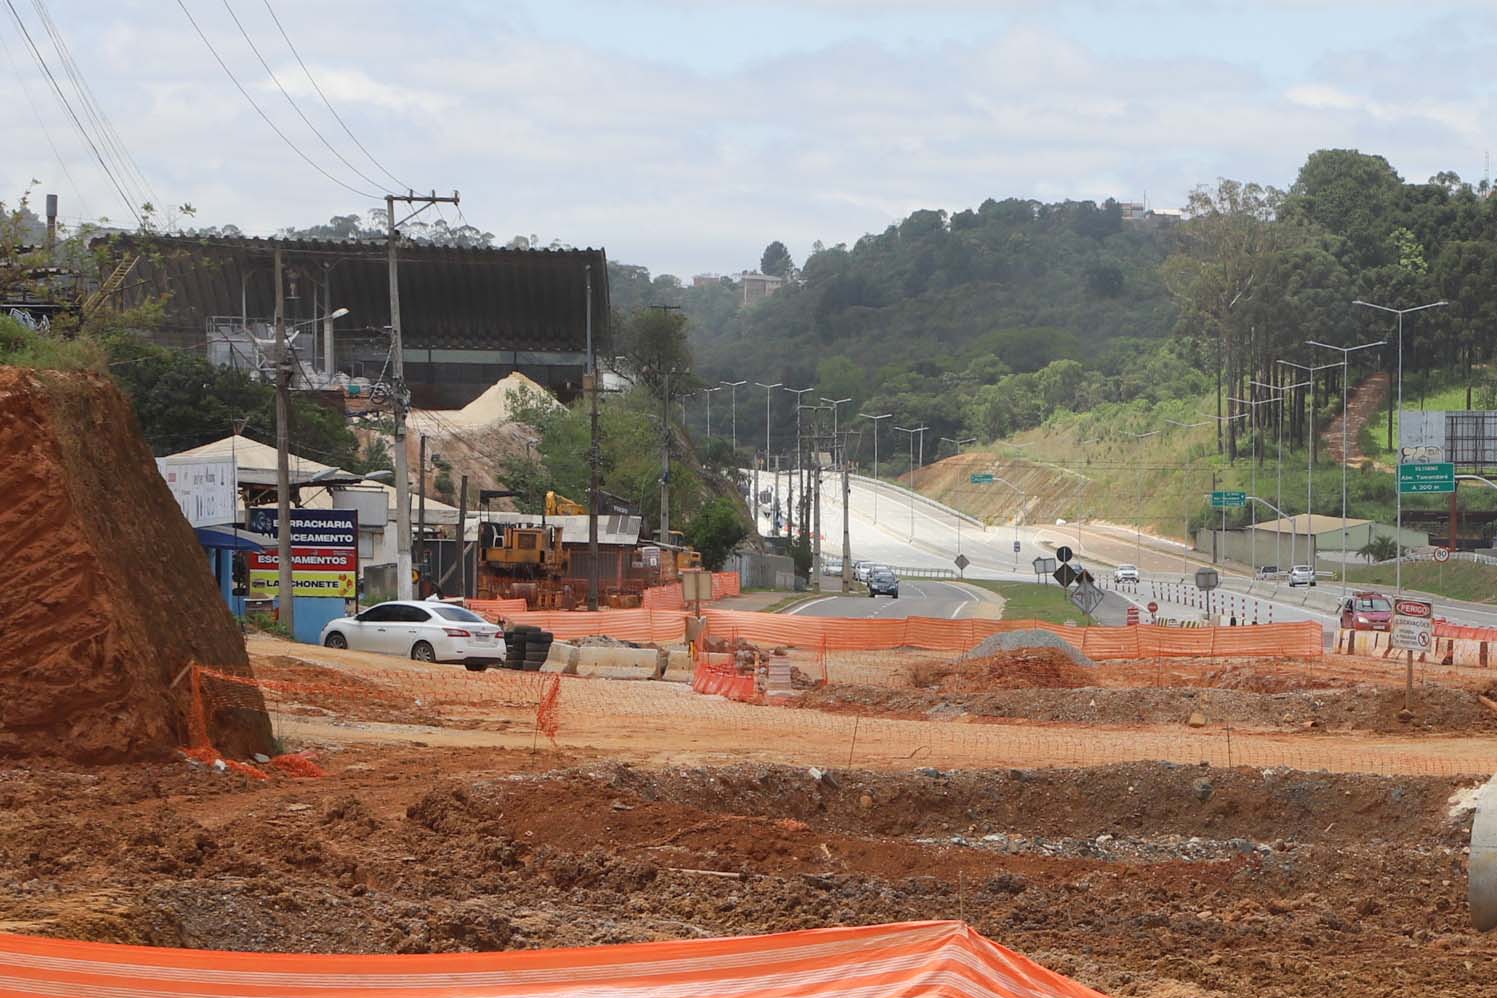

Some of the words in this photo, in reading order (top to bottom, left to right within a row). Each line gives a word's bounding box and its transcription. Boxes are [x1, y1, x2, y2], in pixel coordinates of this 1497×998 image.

[273, 519, 353, 529] BRRACHARIA
[266, 580, 339, 588] LACHONETE
[1400, 603, 1428, 614] PERIGO
